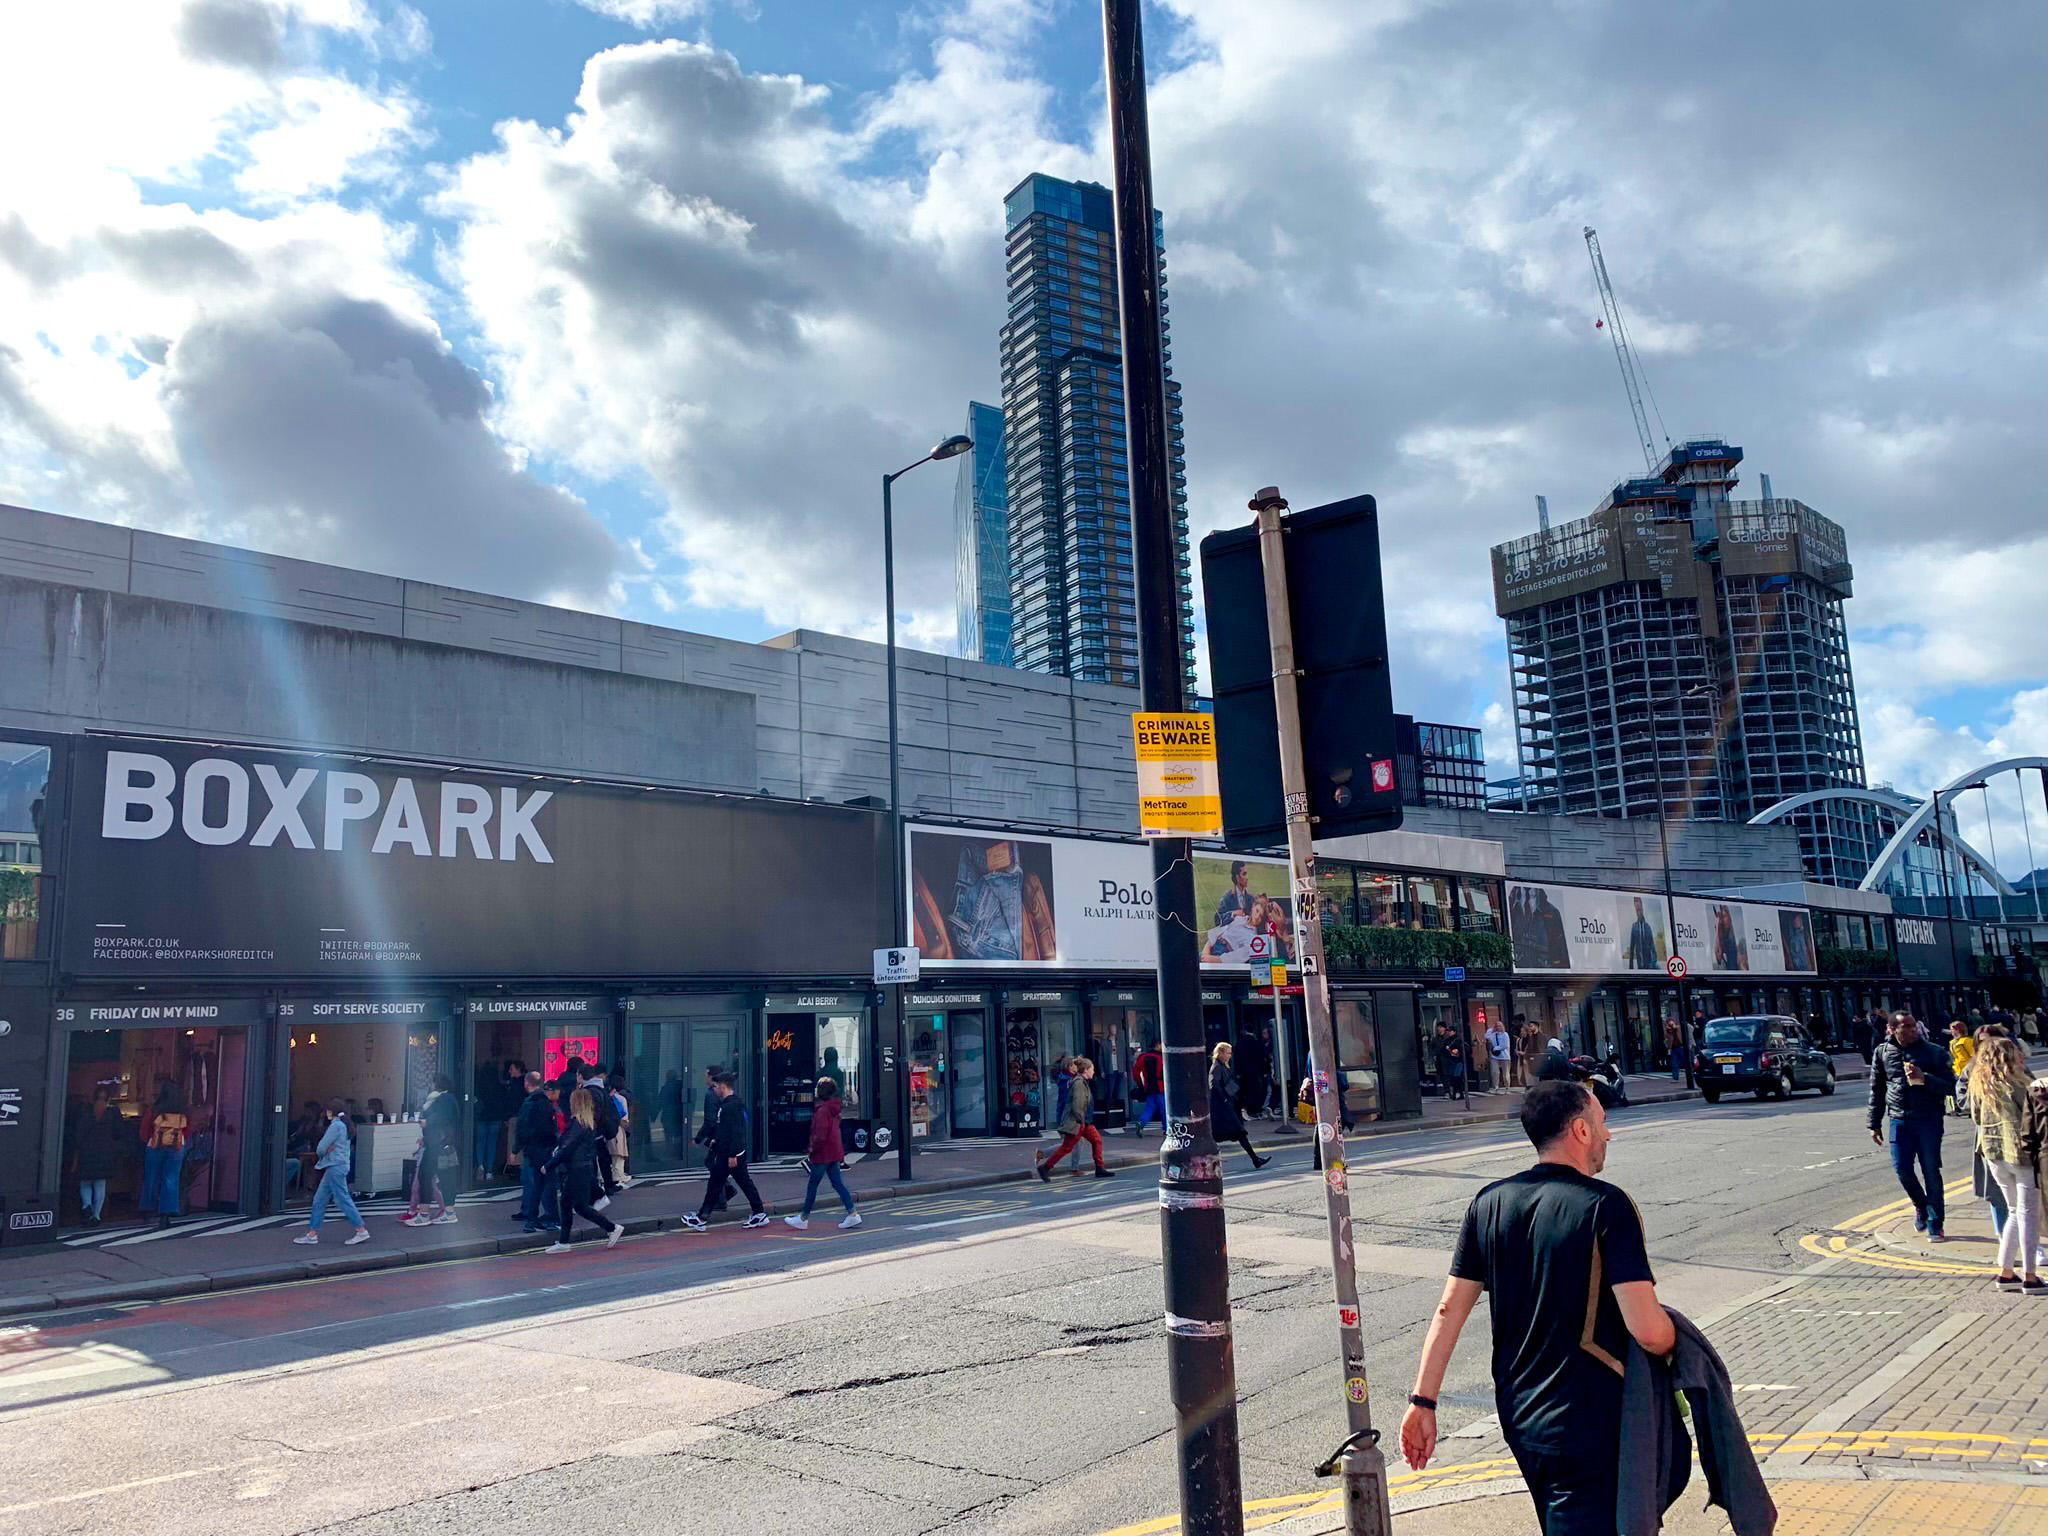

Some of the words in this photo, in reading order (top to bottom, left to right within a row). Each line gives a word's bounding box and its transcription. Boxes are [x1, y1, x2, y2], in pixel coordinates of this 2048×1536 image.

[1695, 448, 1723, 456] O'SHEA
[1754, 543, 1788, 553] Homes
[1504, 568, 1531, 585] 020
[1535, 558, 1568, 576] 3770
[1573, 545, 1606, 565] 2154
[1506, 561, 1608, 598] THESTAGESHOREDITCH.COM
[1137, 720, 1210, 730] CRIMINALS
[1138, 732, 1211, 745] BEWARE
[102, 750, 554, 864] BOXPARK
[1144, 800, 1188, 809] MetTrace
[1098, 879, 1153, 905] Polo
[1083, 906, 1123, 919] RALPH
[1126, 909, 1155, 920] LAUR
[1579, 917, 1606, 935] Polo
[1676, 923, 1698, 939] Polo
[1894, 918, 1937, 945] BOXPARK
[1574, 936, 1594, 945] RALPH
[1594, 936, 1614, 945] LAUREN
[1755, 928, 1773, 943] Polo
[94, 938, 180, 948] BOXPARK.CO.UK
[320, 941, 362, 950] TWITTER:
[363, 942, 410, 951] @BOXPARK
[93, 949, 153, 959] FACEBOOK:
[154, 950, 274, 960] @BOXPARKSHOREDITCH
[319, 951, 373, 960] INSTAGRAM:
[375, 952, 421, 961] @BOXPARK
[886, 967, 908, 975] Traffic
[1669, 962, 1685, 973] 20
[876, 973, 918, 982] enforcement
[797, 996, 814, 1006] ACAI
[815, 996, 839, 1006] BERRY
[912, 994, 944, 1004] DUMDUMS
[944, 994, 981, 1004] DONUTTERIE
[1022, 992, 1061, 1001] SPRAYGROUND
[1201, 991, 1222, 1000] ONCEPTS
[279, 1004, 294, 1016] 35
[312, 1003, 341, 1015] SOFT
[343, 1002, 380, 1014] SERVE
[381, 1002, 426, 1014] SOCIETY
[469, 1002, 483, 1013] 34
[488, 1002, 514, 1012] LOVE
[515, 1001, 548, 1012] SHACK
[549, 1000, 587, 1011] VINTAGE
[56, 1009, 75, 1021] 36
[90, 1008, 139, 1020] FRIDAY
[141, 1007, 161, 1019] ON
[163, 1007, 183, 1018] MY
[185, 1006, 218, 1018] MIND
[1340, 1309, 1357, 1325] Lie
